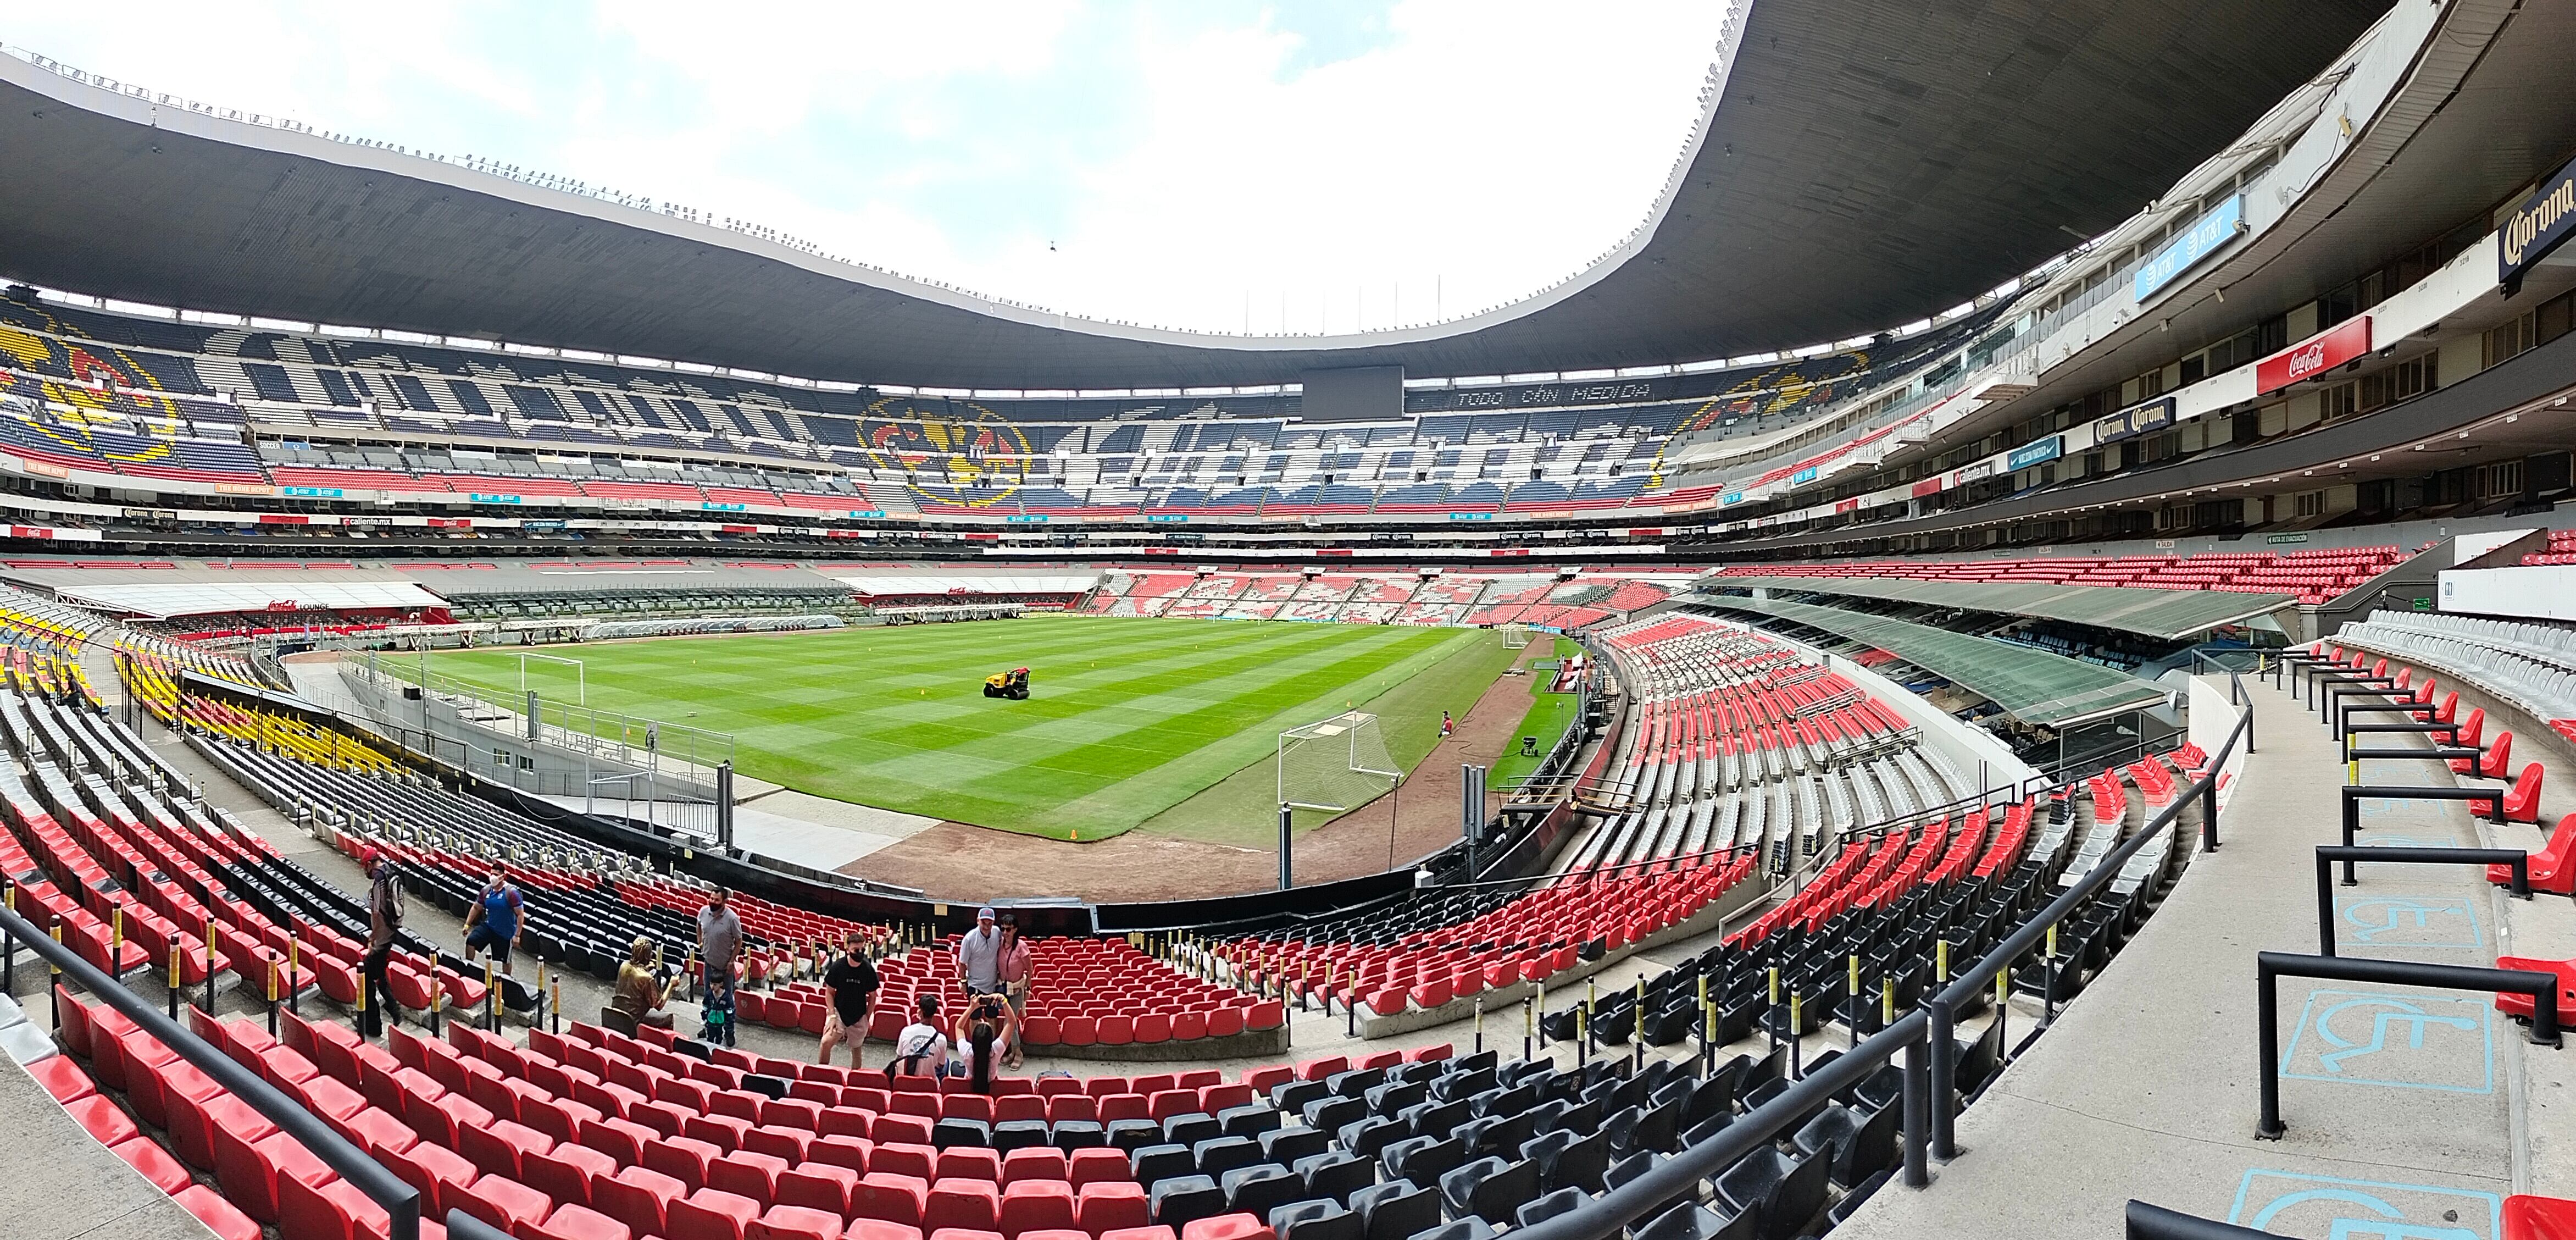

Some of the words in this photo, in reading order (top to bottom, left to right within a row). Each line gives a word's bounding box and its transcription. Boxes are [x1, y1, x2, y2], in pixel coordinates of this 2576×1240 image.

[2199, 215, 2224, 248] AT&T
[2504, 179, 2575, 266] Corona
[2157, 252, 2177, 281] AT&T
[2289, 341, 2325, 378] Coca-Cola
[1458, 392, 1504, 406] TODO
[1571, 384, 1650, 401] MEDIDA
[2096, 418, 2125, 443] Corona
[2131, 404, 2166, 432] Corona
[1959, 463, 1990, 484] caliente.mx
[125, 508, 148, 517] Corona
[153, 510, 174, 519] Corona
[350, 518, 390, 526] caliente.mx
